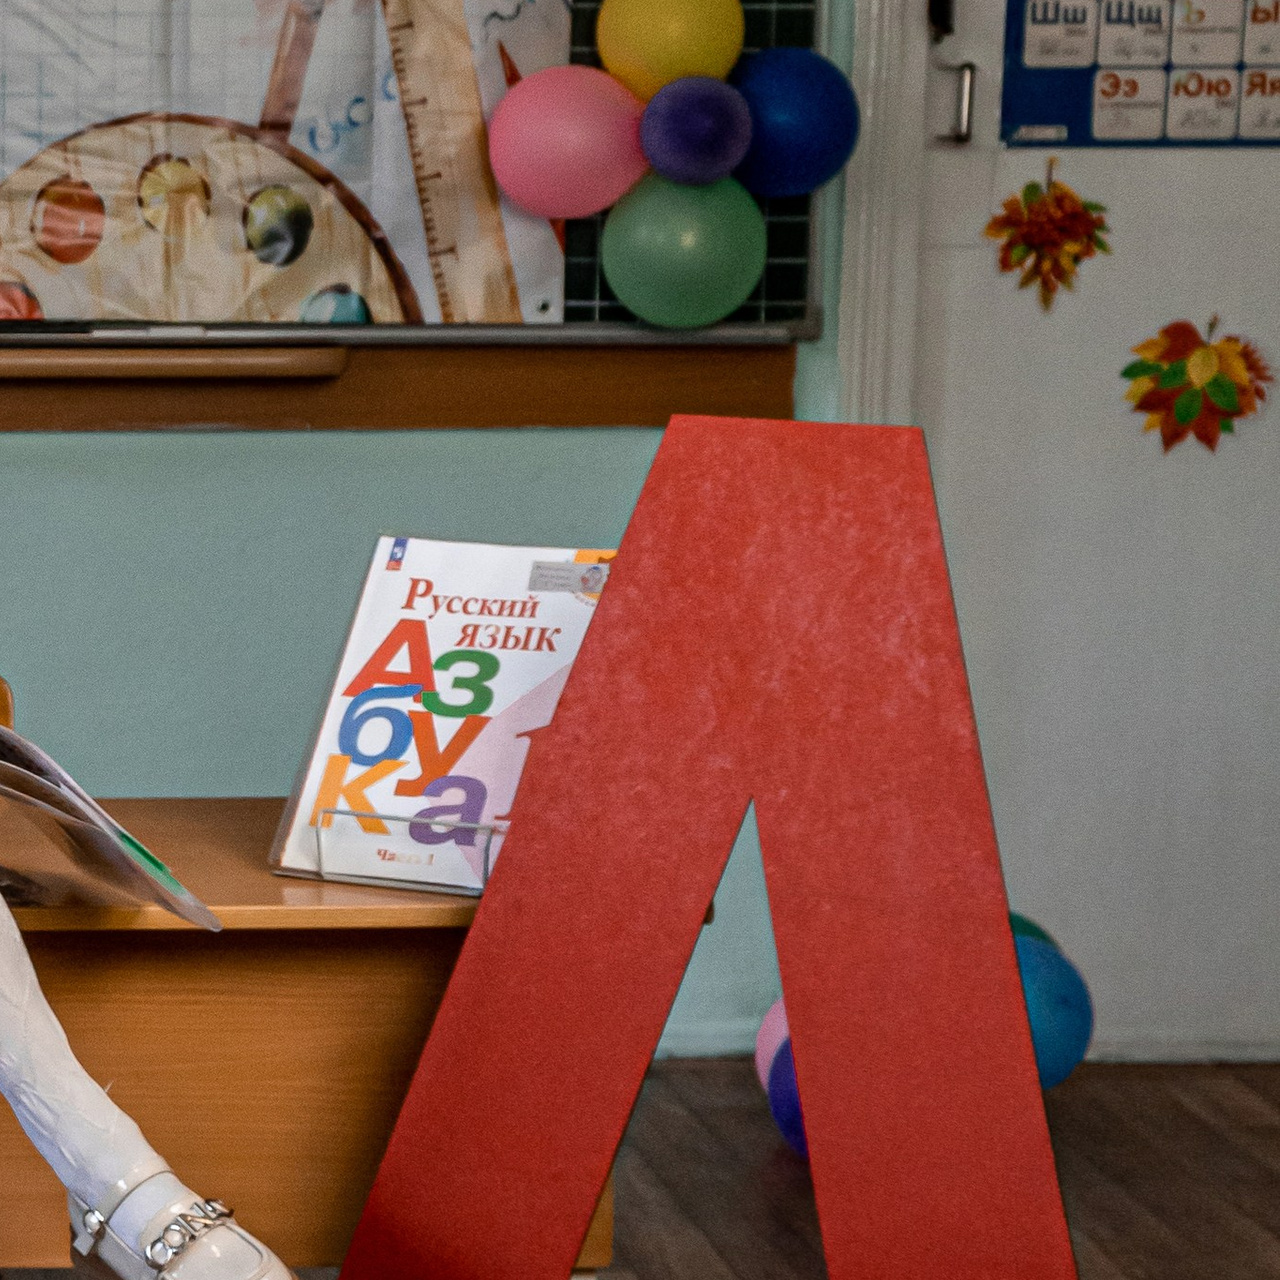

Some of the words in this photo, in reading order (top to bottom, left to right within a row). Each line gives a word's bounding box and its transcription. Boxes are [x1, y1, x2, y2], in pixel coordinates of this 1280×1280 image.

[1030, 1, 1088, 25] Шш
[1105, 0, 1163, 28] Щщ
[1100, 72, 1140, 99] Ээ
[1173, 71, 1232, 99] Юю
[401, 577, 541, 619] Русский
